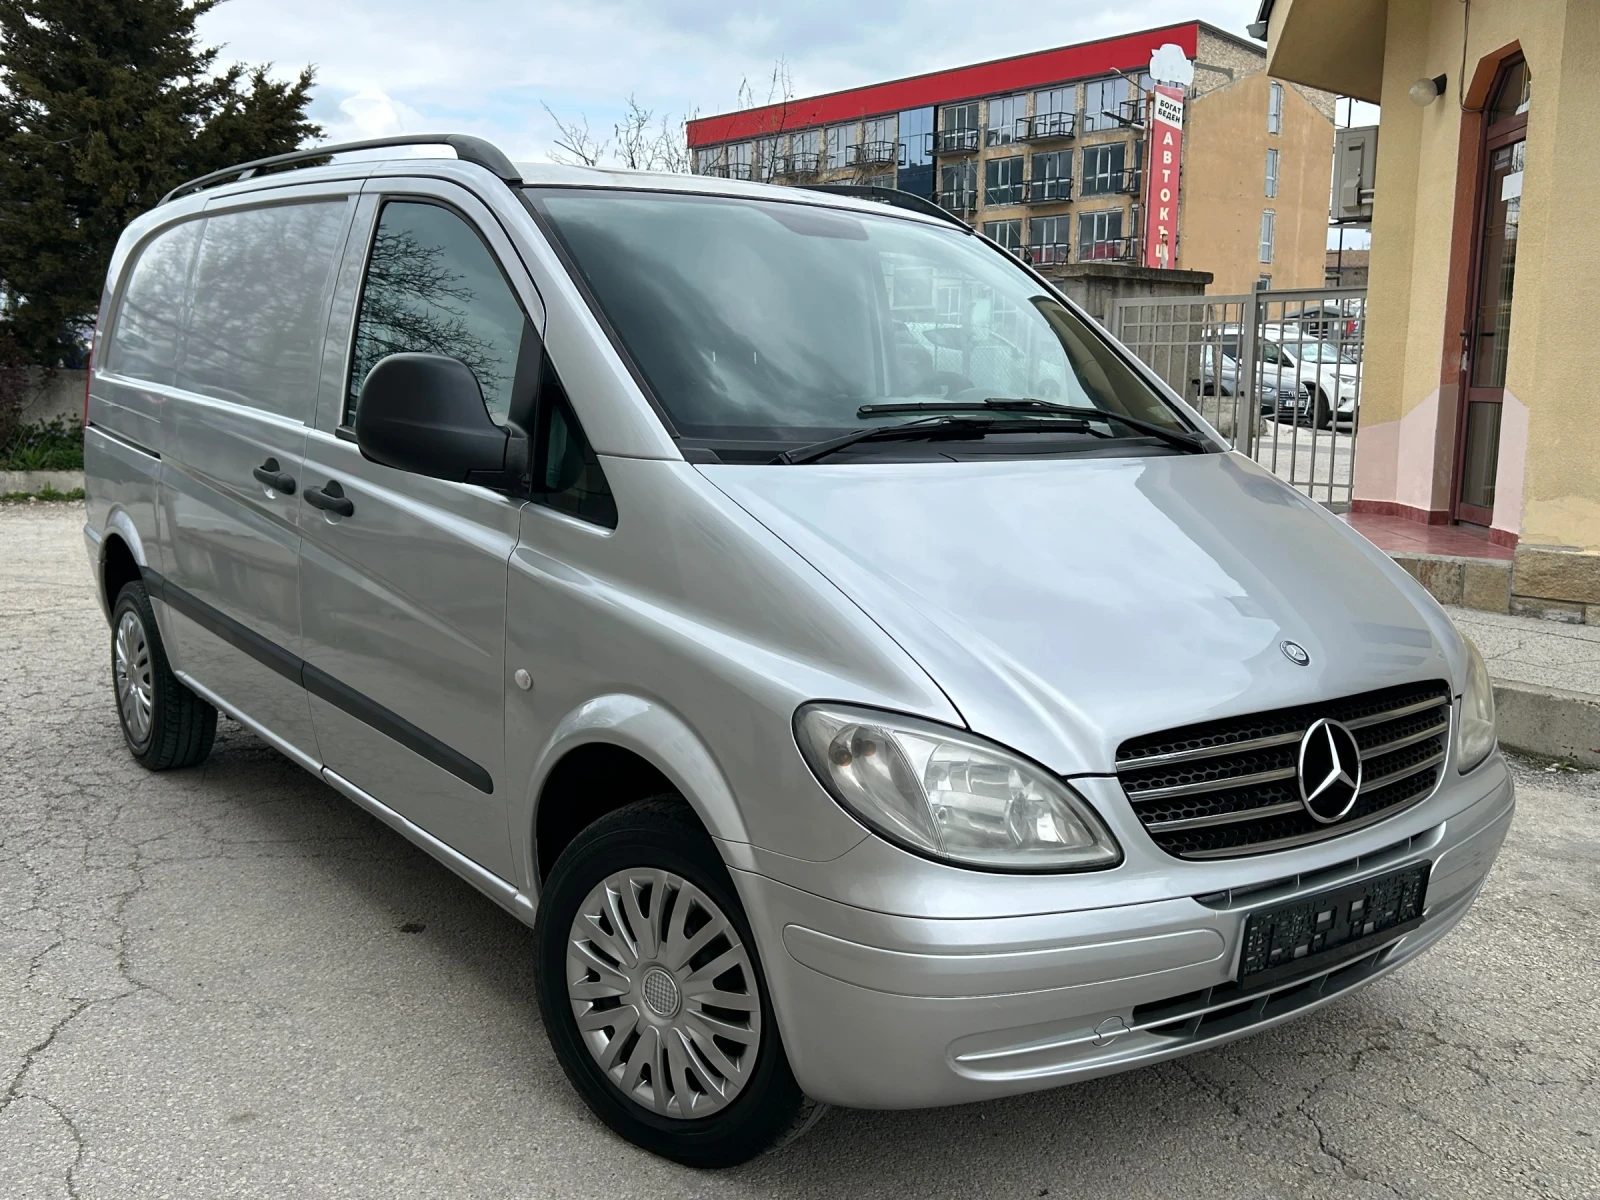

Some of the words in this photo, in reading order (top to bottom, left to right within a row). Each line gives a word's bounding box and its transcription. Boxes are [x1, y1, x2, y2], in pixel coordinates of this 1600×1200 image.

[1160, 100, 1181, 114] БОГАТ
[1158, 108, 1180, 123] БЕДЕН
[1155, 131, 1173, 268] АВТОКЪЩ
